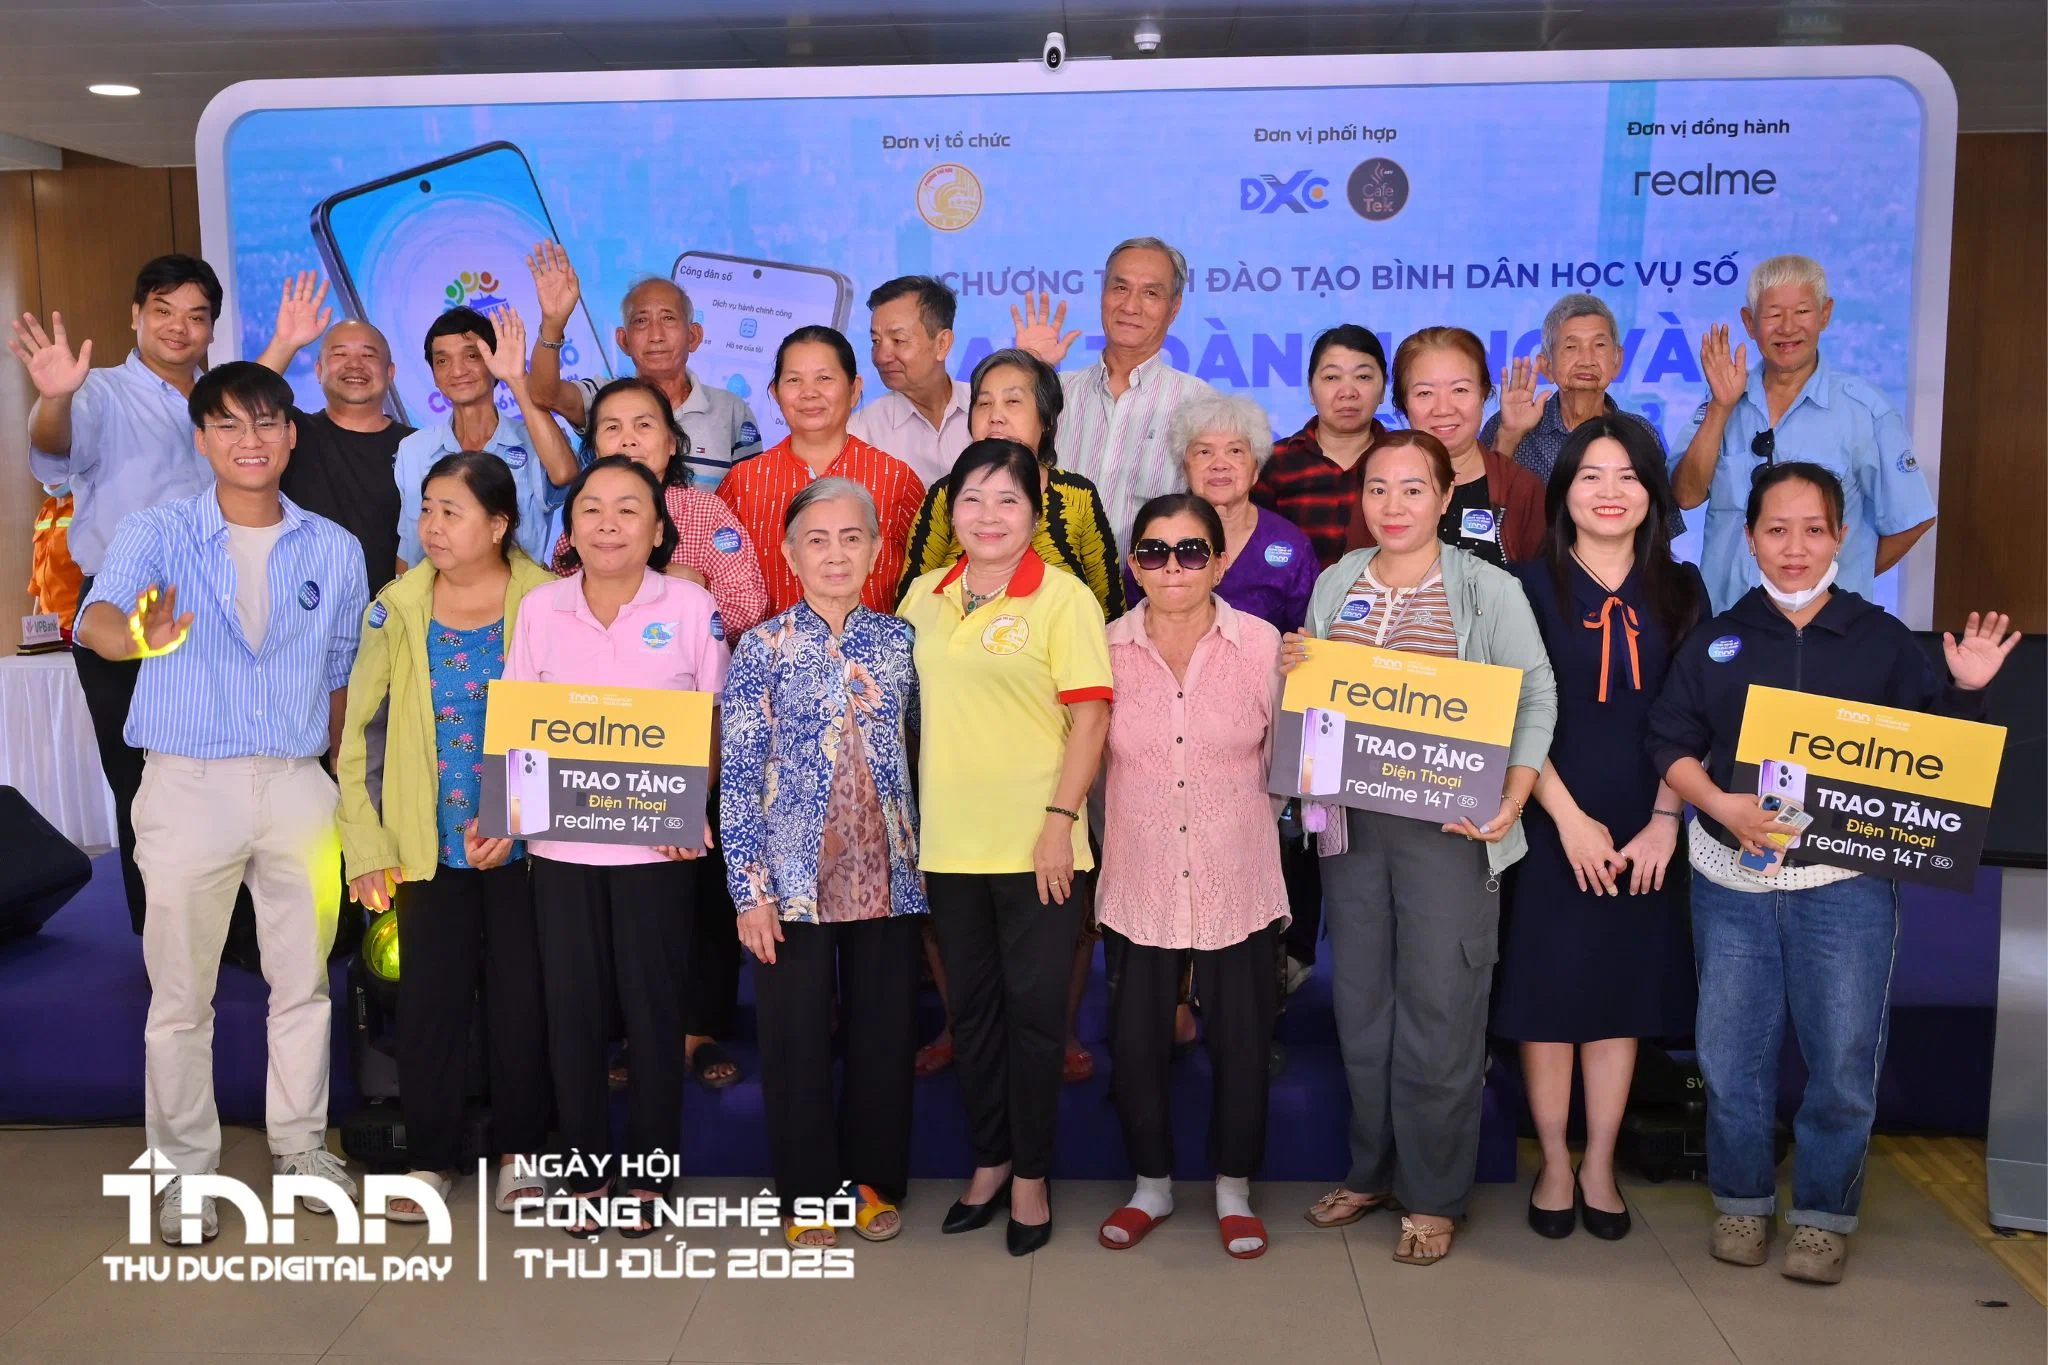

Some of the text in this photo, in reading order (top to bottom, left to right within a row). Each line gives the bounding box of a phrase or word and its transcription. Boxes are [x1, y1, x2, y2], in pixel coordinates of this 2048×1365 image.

[882, 130, 1011, 152] Đơn vị tổ chức
[1254, 123, 1397, 145] Đơn vị phối hợp
[1627, 117, 1790, 138] Đơn vị đồng hành
[1241, 169, 1330, 214] DXC
[1634, 162, 1777, 196] realme
[1362, 198, 1394, 213] Tek
[1205, 261, 1282, 293] ĐÀO
[1292, 264, 1360, 299] TẠO
[1372, 259, 1454, 290] BÌNH
[1467, 257, 1540, 290] DÂN
[1552, 261, 1626, 294] HỌC
[1634, 260, 1682, 293] VỤ
[1693, 251, 1739, 287] SỐ
[1329, 679, 1468, 722] realme
[531, 715, 666, 749] realme
[1354, 733, 1485, 773] TRAO TẶNG
[1789, 730, 1944, 780] realme
[559, 769, 687, 798] TRAO TẶNG
[1381, 762, 1463, 789] Điện Thoại
[588, 794, 667, 812] Điện Thoại
[1345, 778, 1475, 810] realme 14T 5G
[1816, 787, 1962, 833] TRAO TẶNG
[555, 813, 682, 833] realme 14T 5G
[1846, 818, 1936, 849] Điện Thoại
[1806, 832, 1951, 870] realme 14T 5G
